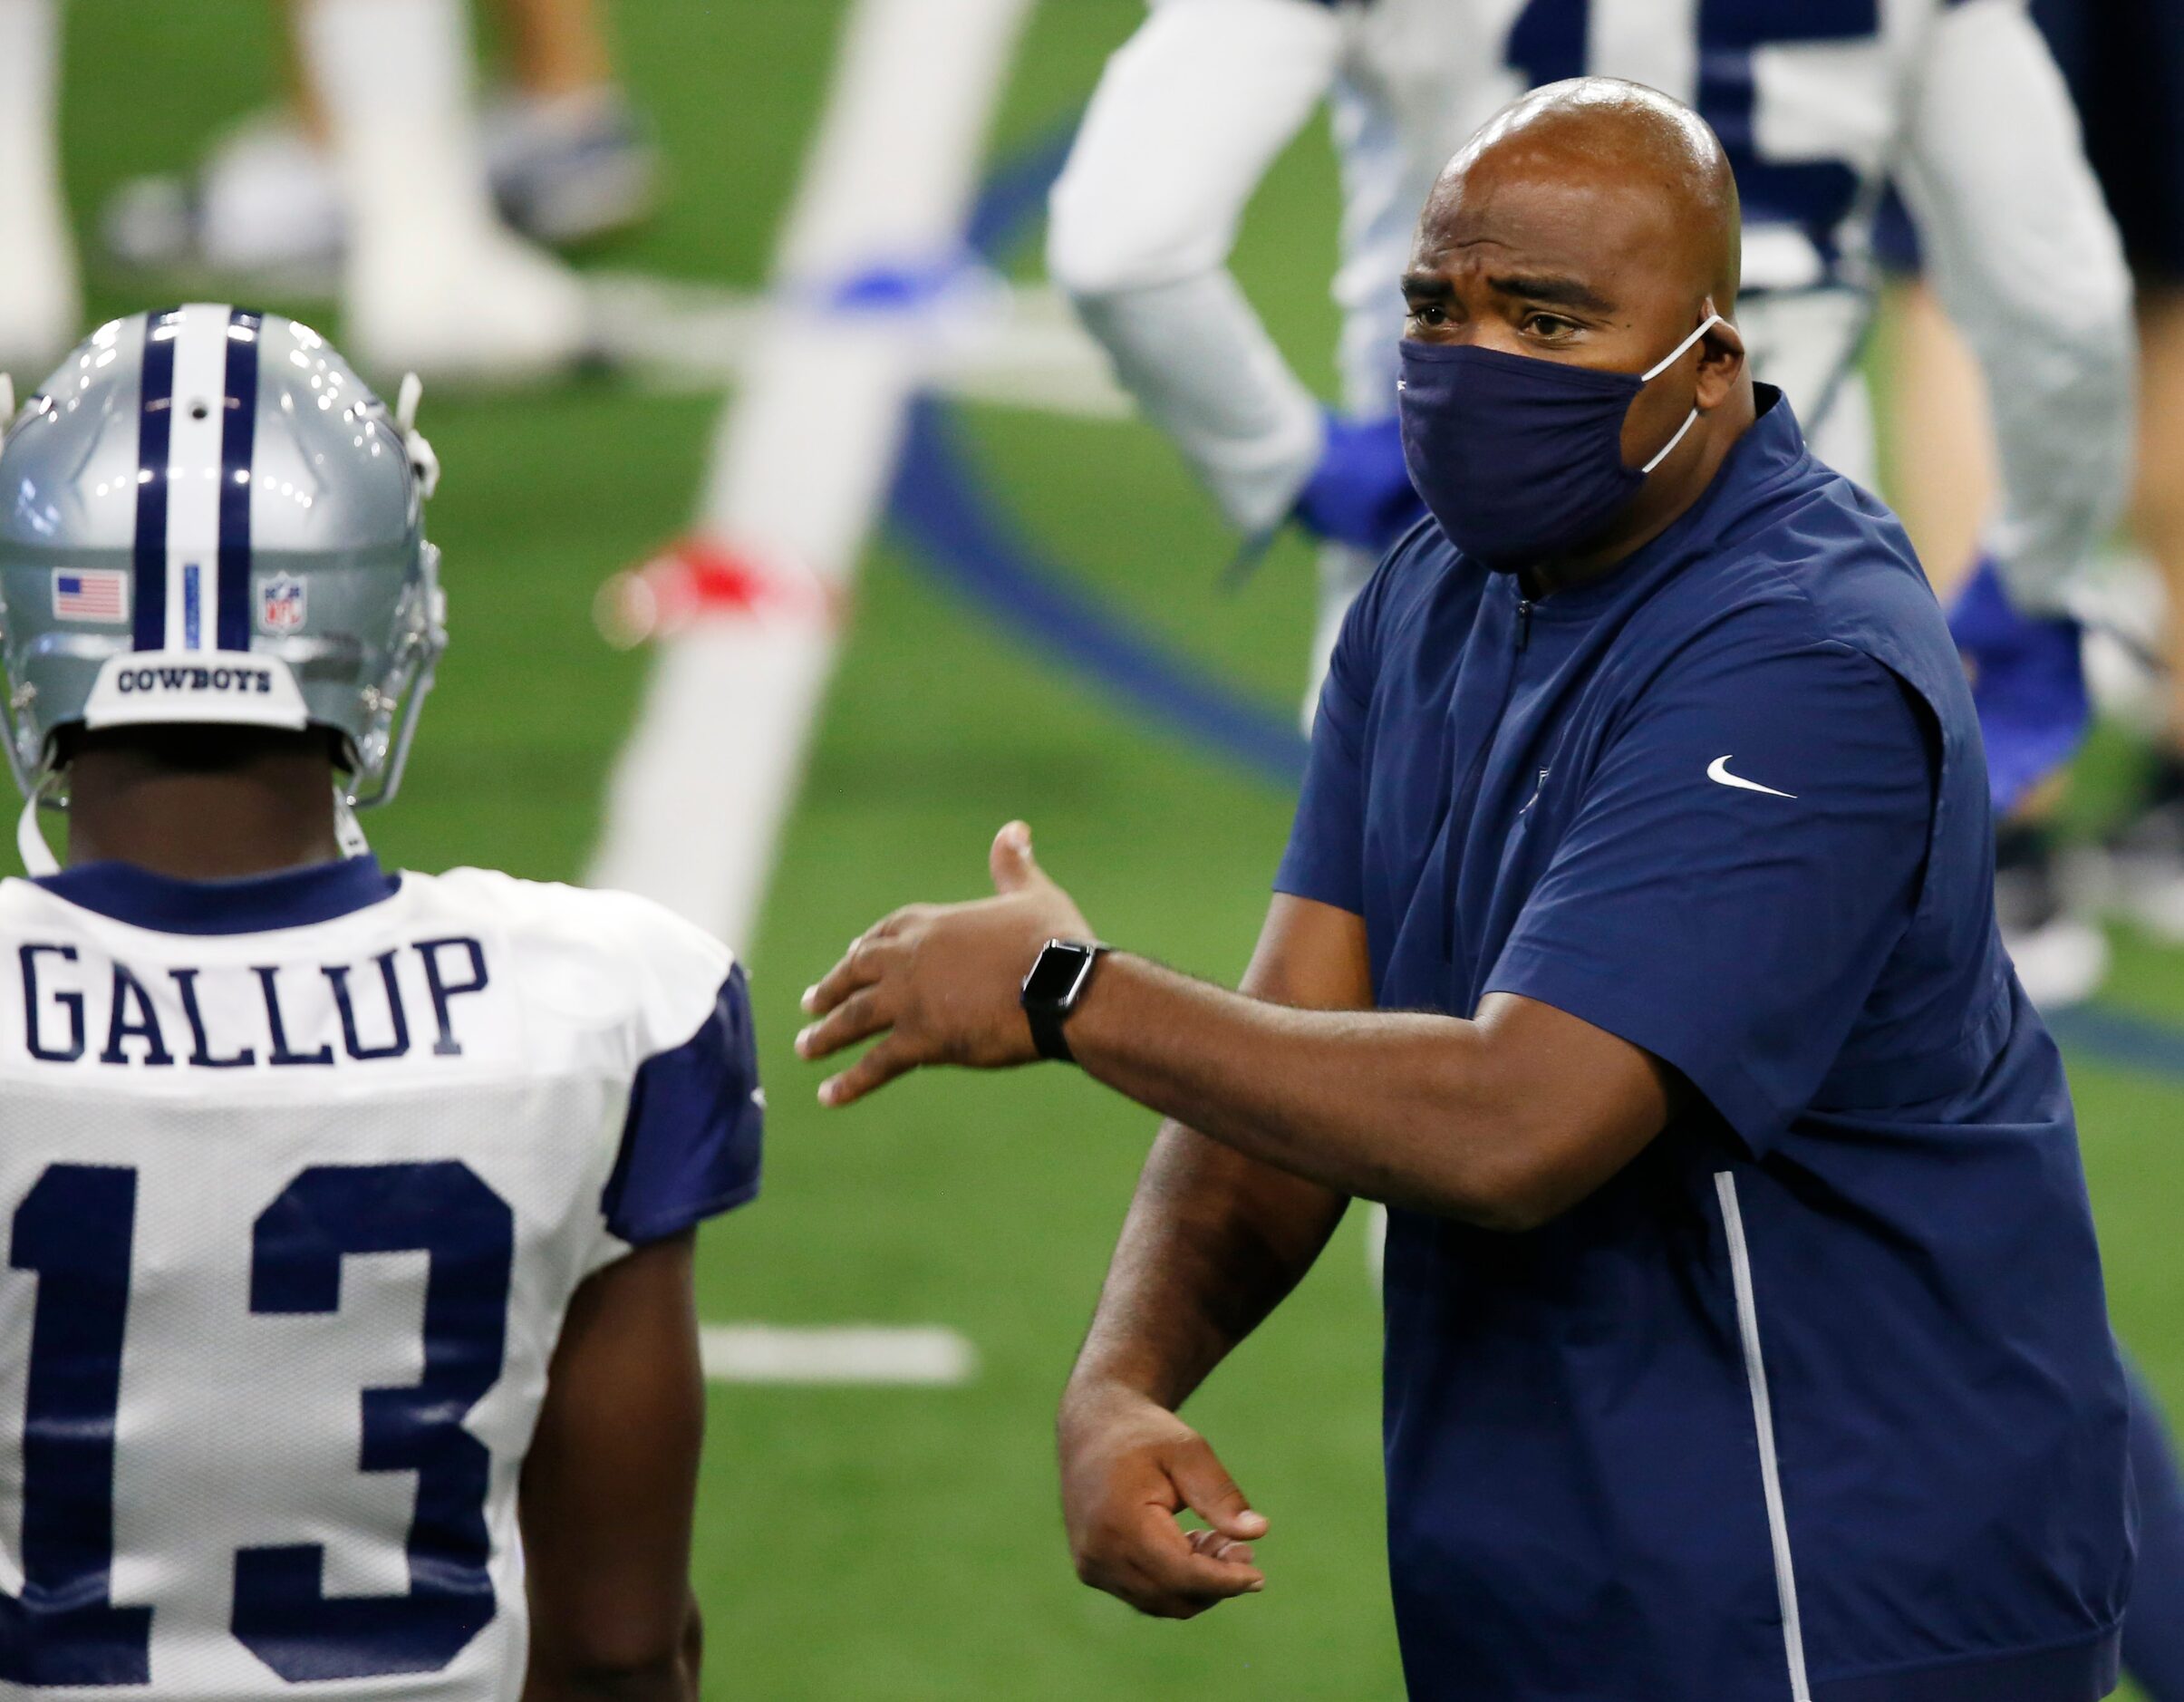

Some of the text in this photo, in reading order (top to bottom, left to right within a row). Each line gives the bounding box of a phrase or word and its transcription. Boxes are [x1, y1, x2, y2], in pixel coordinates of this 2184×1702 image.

[118, 666, 271, 693] COWBOYS
[18, 936, 489, 1068] GALLUP
[0, 1159, 515, 1684] 13
